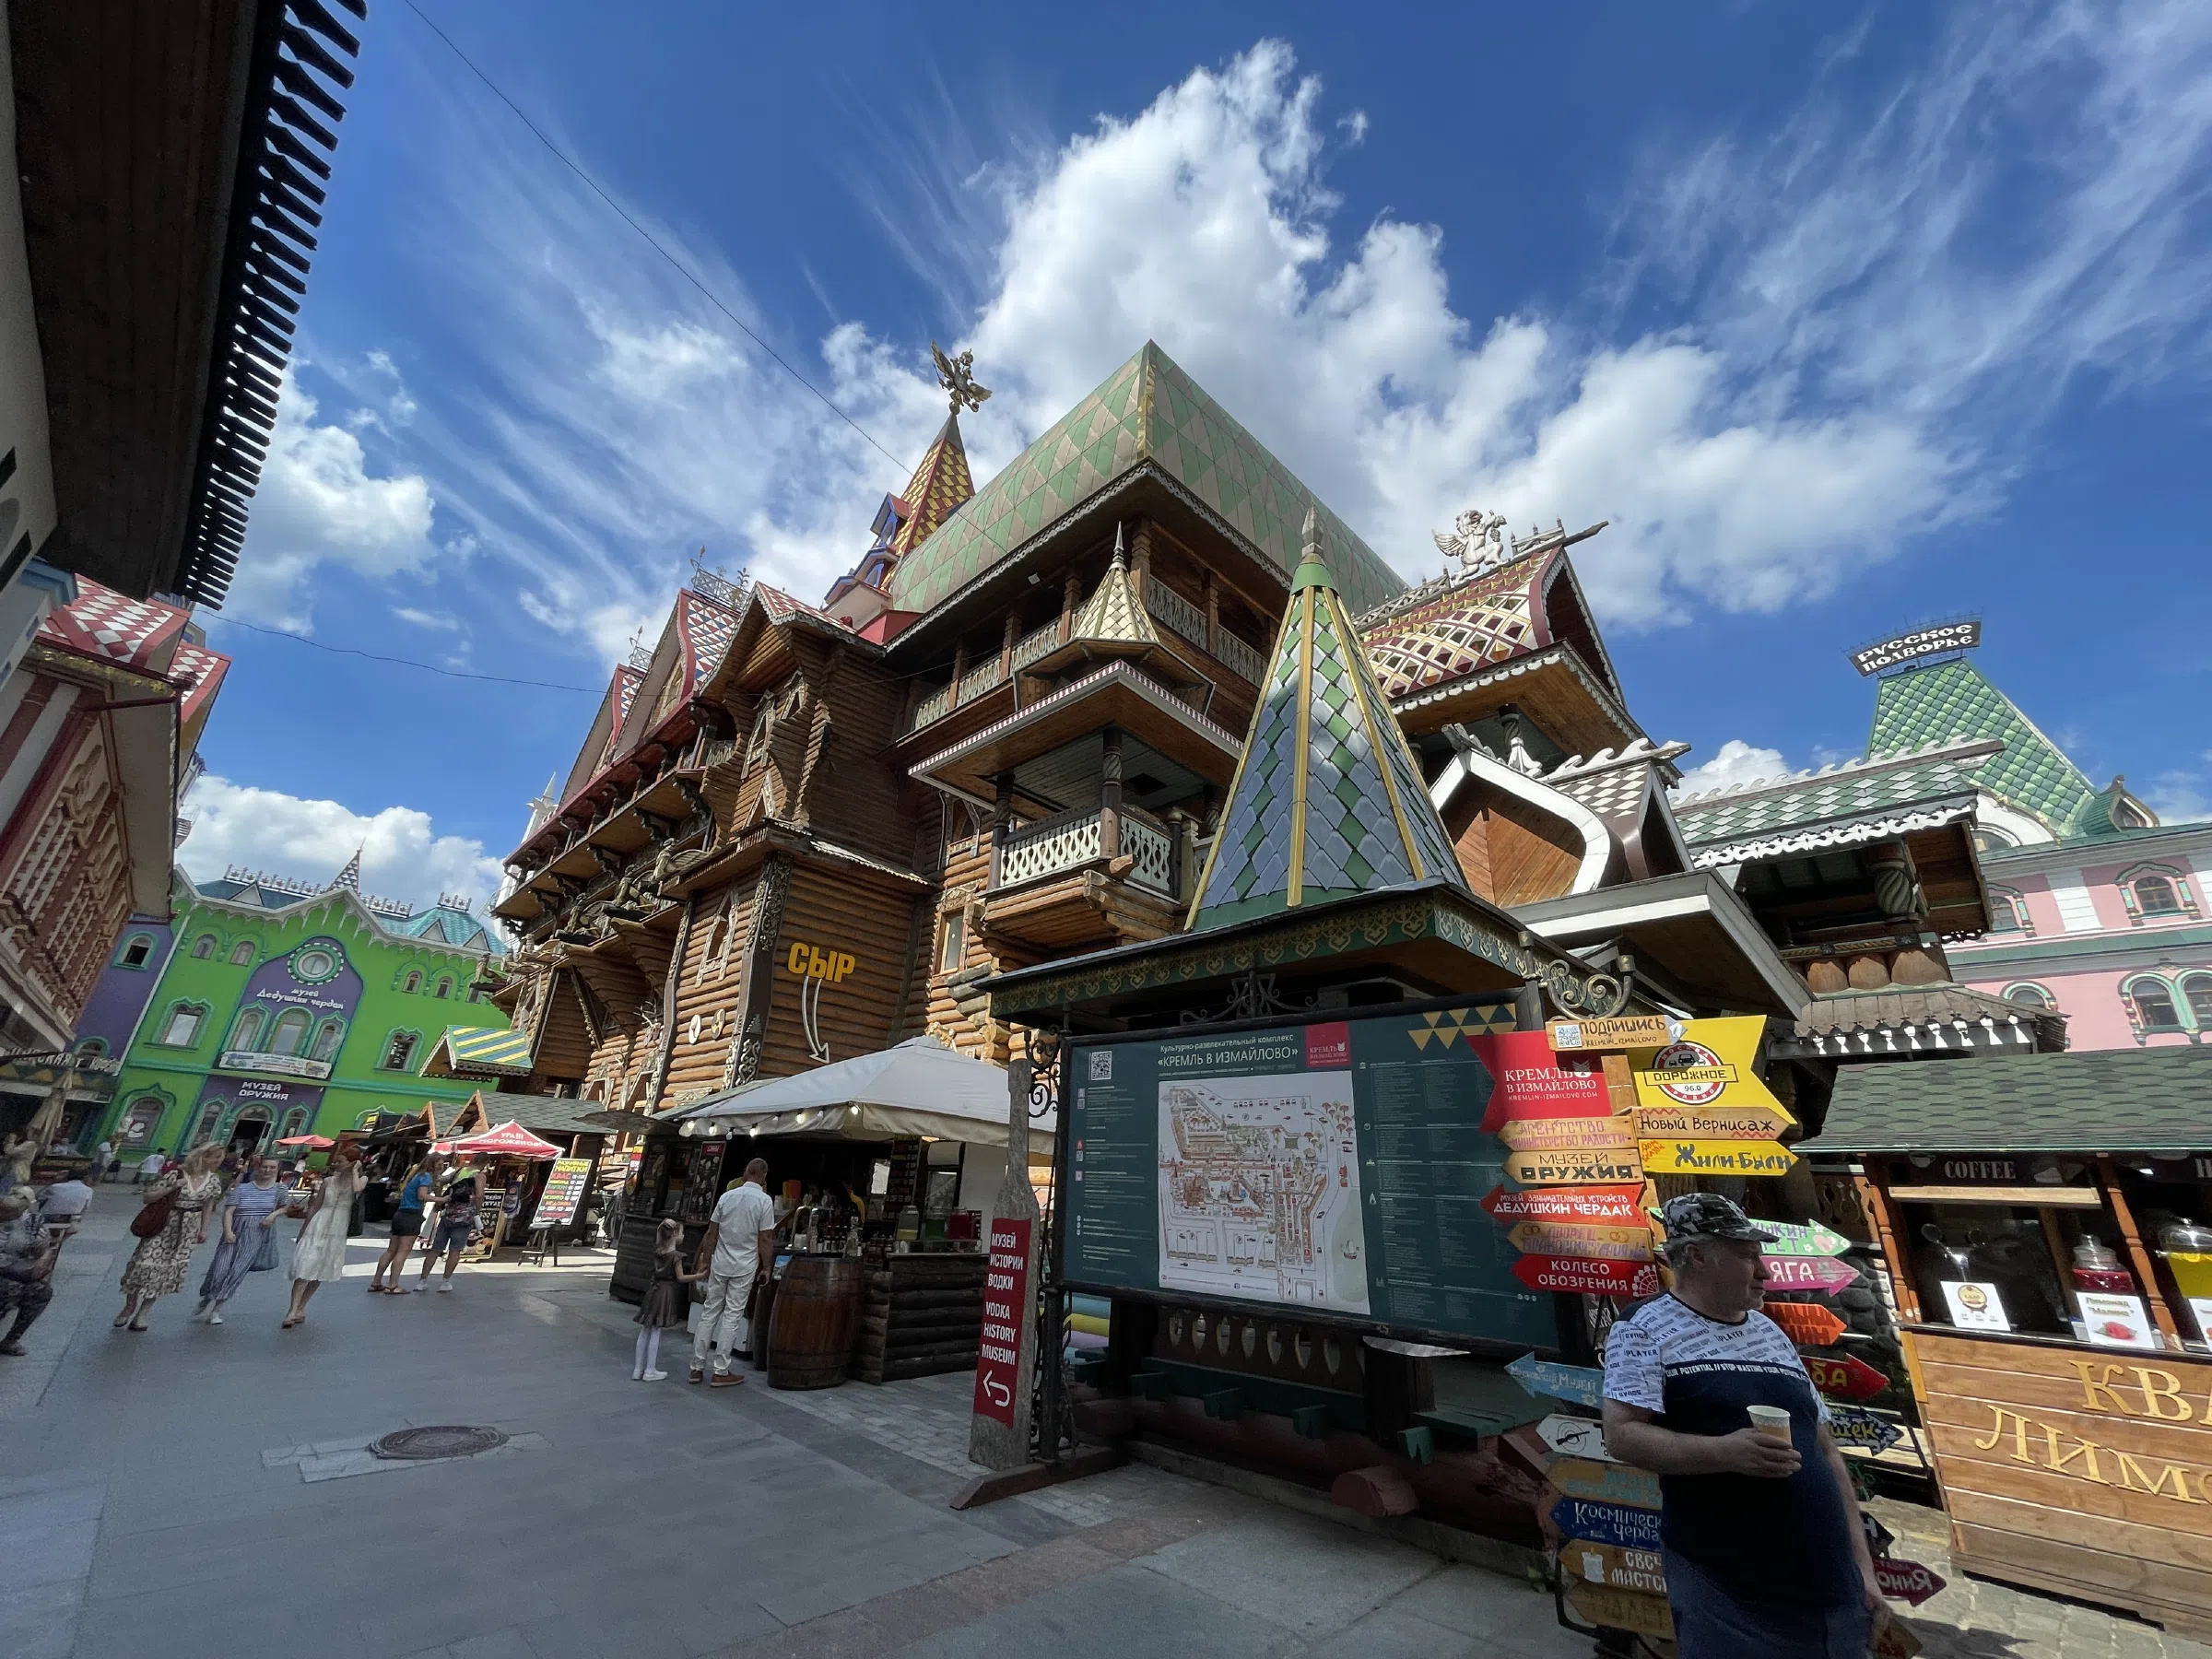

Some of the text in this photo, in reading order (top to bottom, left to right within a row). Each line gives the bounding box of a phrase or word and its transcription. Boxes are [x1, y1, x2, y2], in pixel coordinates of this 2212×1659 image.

[1857, 624, 1972, 662] РУССКОЕ
[1862, 635, 1972, 672] ПОДВОРЬЕ
[788, 942, 855, 982] СЫР
[1580, 1017, 1666, 1037] ПОДПИШИСЬ
[1258, 1033, 1294, 1044] комплекс
[1158, 1053, 1204, 1067] «КРЕМЛЬ
[1206, 1053, 1214, 1065] В
[1216, 1046, 1299, 1064] ИЗМАЙЛОВО»
[1504, 1066, 1574, 1082] КРЕМЛЬ
[1653, 1069, 1727, 1081] ДОРОЖНОЕ
[239, 1089, 288, 1100] ОРУЖИЯ
[241, 1081, 282, 1091] МУЗЕЙ
[1506, 1079, 1596, 1093] В ИЗМАЙЛОВО
[1640, 1115, 1775, 1134] Новый Вернисаж
[1539, 1152, 1609, 1165] МУЗЕЙ
[1521, 1165, 1637, 1181] ОРУЖИЯ
[1944, 1160, 2017, 1180] COFFEE
[1500, 1193, 1523, 1202] МУЗЕЙ
[1588, 1193, 1628, 1204] УСТРОЙСТВ
[1493, 1203, 1633, 1217] ДЕДУШКИН ЧЕРДАК
[991, 1232, 1016, 1248] МУЗЕЙ
[990, 1253, 1024, 1271] ИСТОРИИ
[1551, 1260, 1610, 1275] КОЛЕСО
[1770, 1261, 1815, 1283] ЯГА
[988, 1273, 1014, 1290] ВОДКИ
[1537, 1274, 1629, 1291] ОБОЗРЕНИЯ
[985, 1301, 1010, 1320] VODKA
[983, 1323, 1016, 1343] HISTORY
[982, 1344, 1016, 1366] MUSEUM
[1625, 1349, 1658, 1358] PLAYER
[1665, 1369, 1678, 1378] OUR
[1679, 1364, 1713, 1374] POTENTIAL
[1574, 1502, 1662, 1529] Космическ
[1614, 1523, 1660, 1542] Черда
